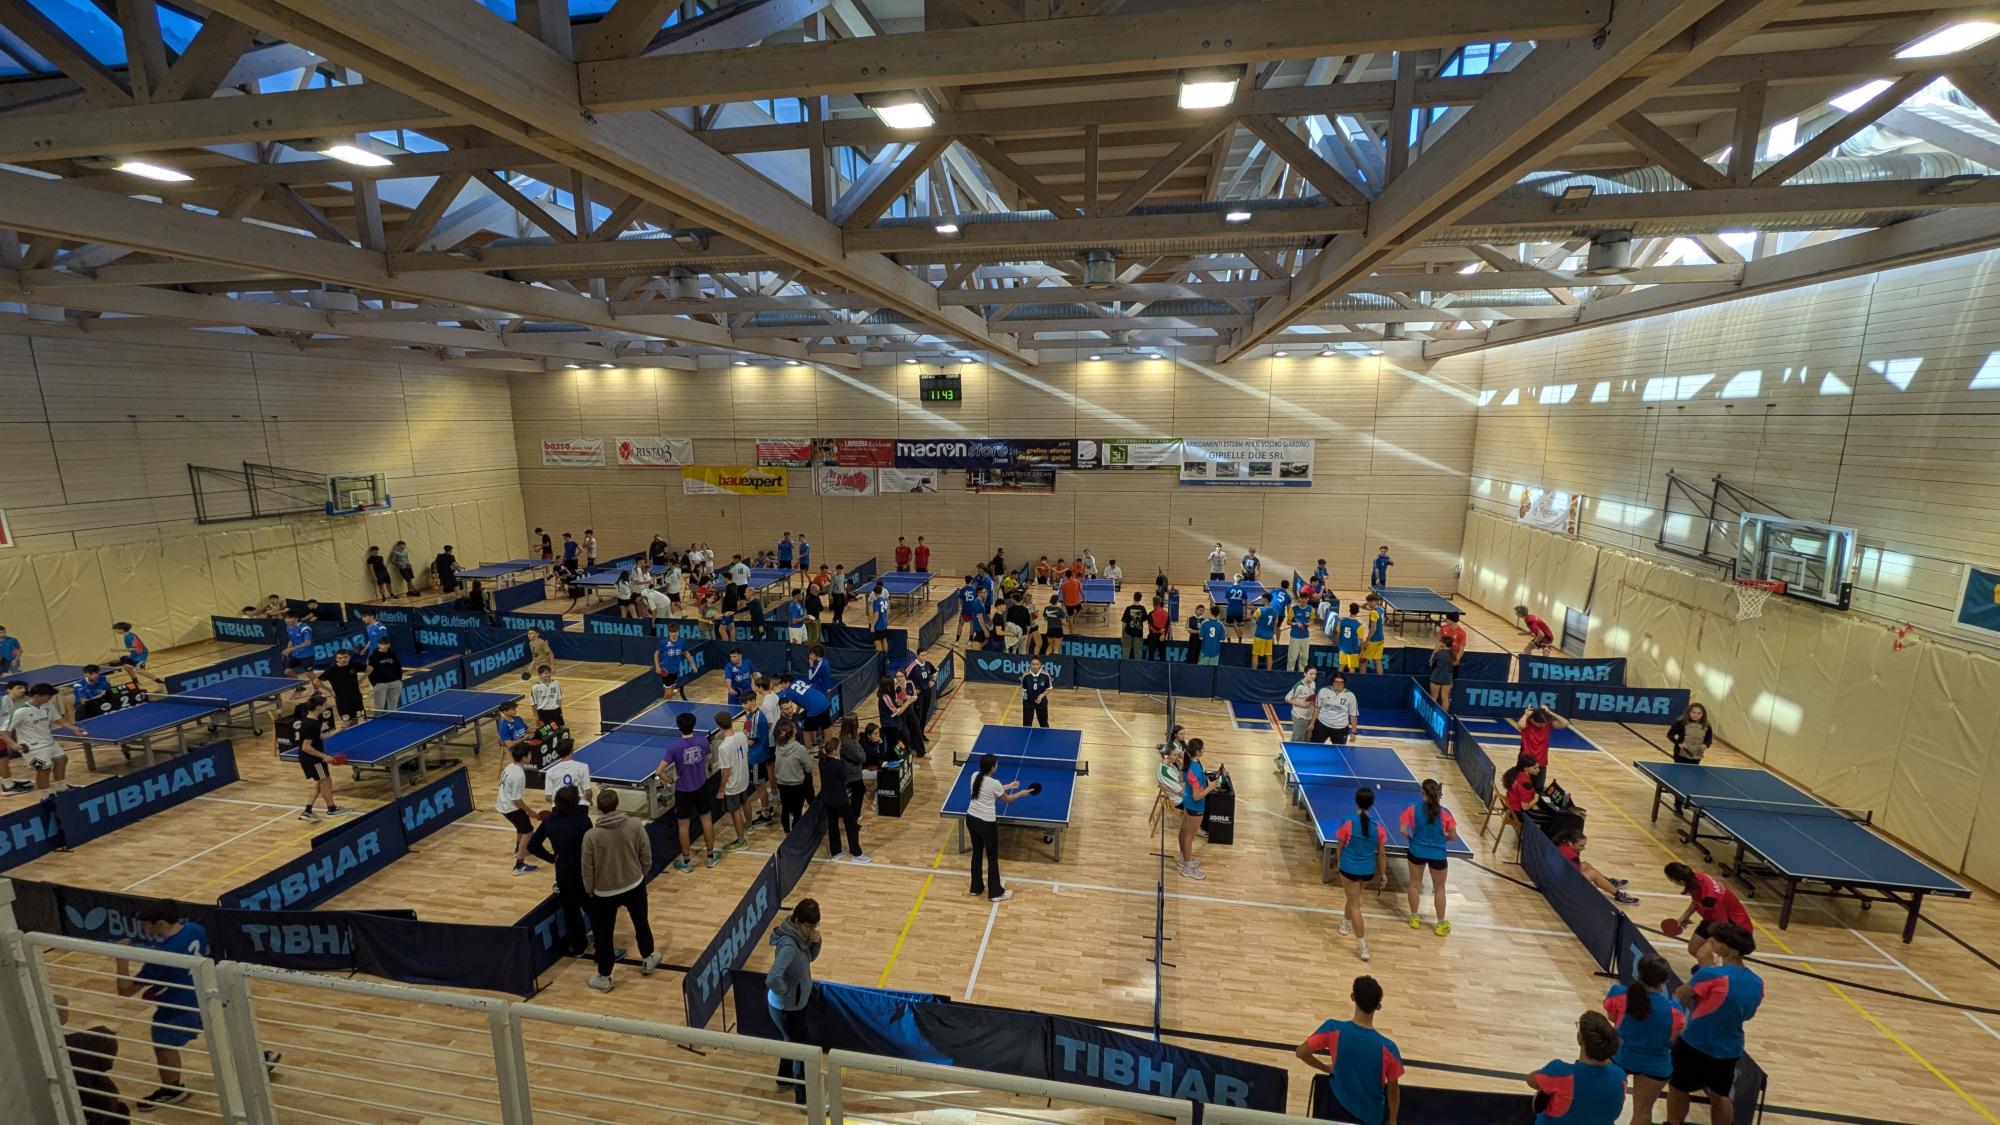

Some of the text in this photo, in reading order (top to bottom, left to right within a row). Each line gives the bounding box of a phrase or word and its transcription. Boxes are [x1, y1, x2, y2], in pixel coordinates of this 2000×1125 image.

[897, 442, 1008, 458] macron store
[1209, 452, 1284, 460] GIPIELLE DUE SRL
[719, 474, 783, 489] bauexpert
[964, 590, 974, 602] 15
[1230, 588, 1242, 600] 22
[1277, 592, 1286, 602] 5
[215, 620, 265, 638] TIBHAR
[440, 616, 480, 628] Butterfly
[502, 616, 556, 632] TIBHAR
[590, 620, 644, 637] TIBHAR
[1209, 627, 1216, 638] 3
[1344, 627, 1351, 638] 5
[470, 642, 525, 678] TIBHAR
[1003, 660, 1062, 678] Buttrfly
[1314, 652, 1390, 670] TIAR
[180, 658, 271, 692] TIBHAR
[1528, 662, 1611, 680] TIBHAR
[400, 668, 458, 706] IBHAR
[790, 680, 811, 696] 22
[120, 696, 129, 708] 2
[1466, 687, 1556, 710] TIBHAR
[1575, 692, 1670, 714] TIBHAR
[1413, 686, 1445, 739] TIBHAR
[79, 757, 216, 824] TIBHAR
[402, 786, 455, 832] HAR
[239, 830, 381, 912] TIBHAR
[696, 884, 768, 1003] TIBHAR
[1055, 1034, 1249, 1109] TIBHAR
